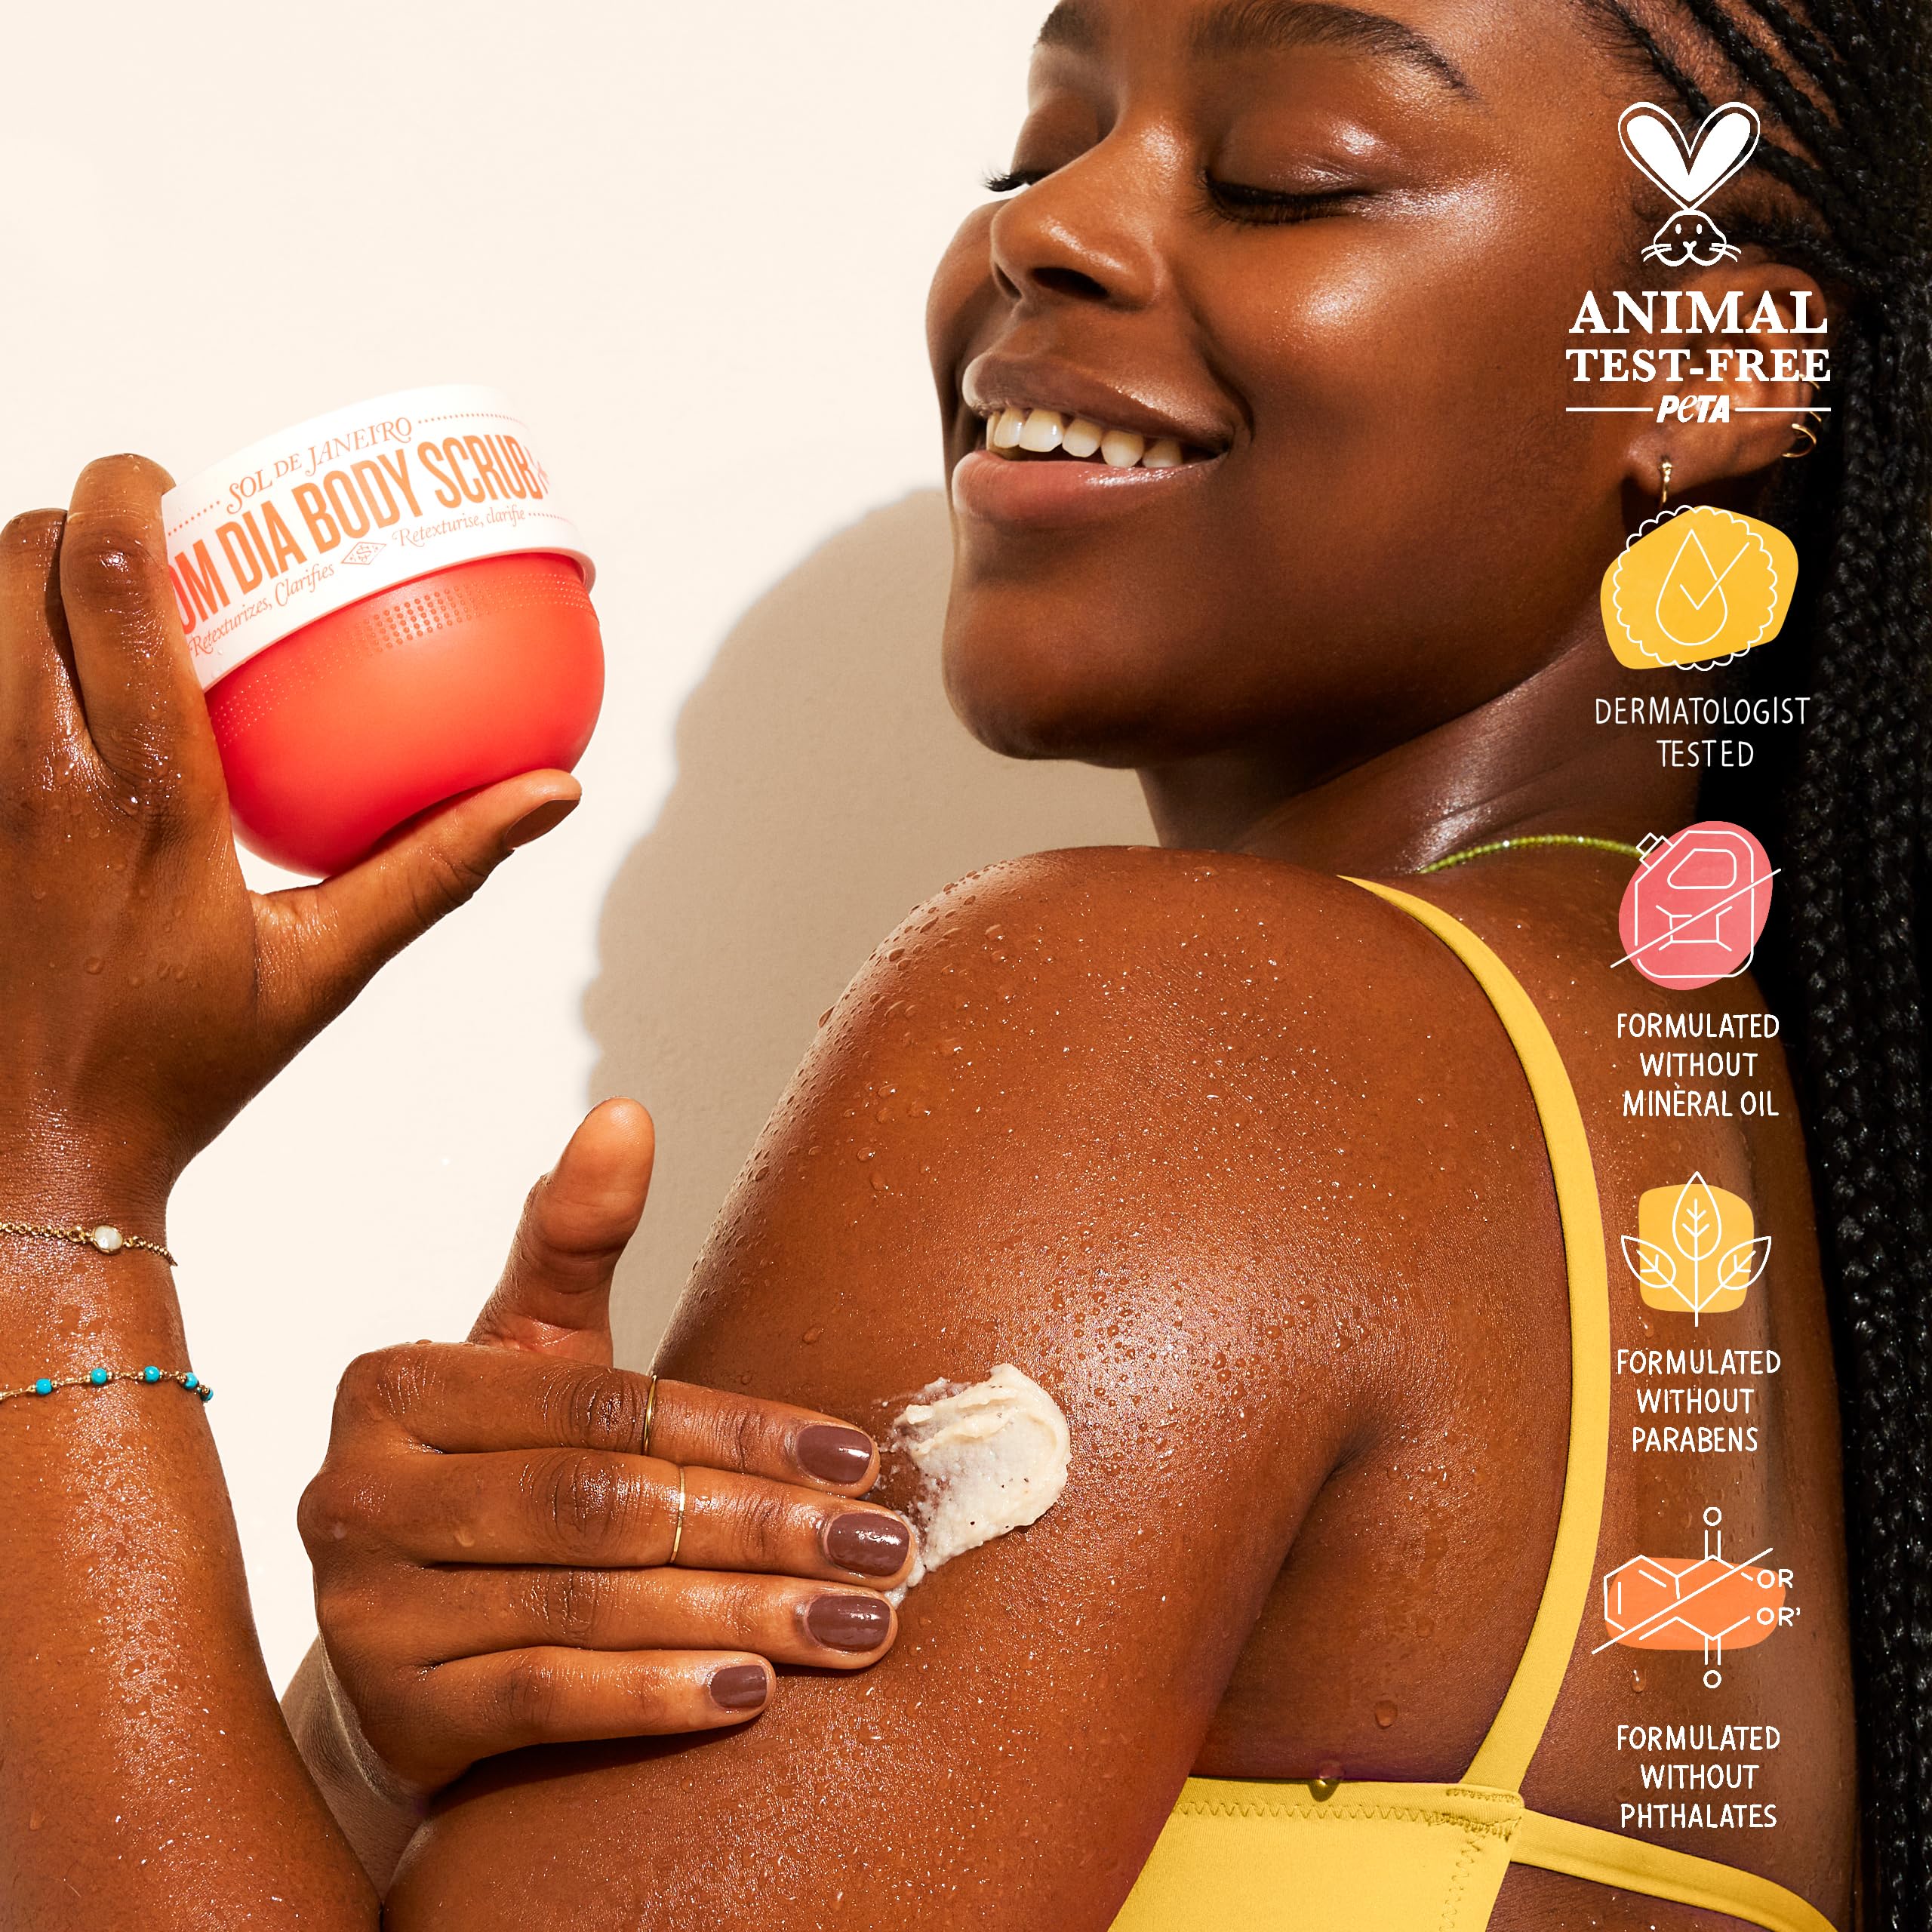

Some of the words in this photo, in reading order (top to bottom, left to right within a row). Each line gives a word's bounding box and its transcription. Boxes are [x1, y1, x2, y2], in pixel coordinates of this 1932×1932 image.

[226, 469, 273, 515] SOL
[273, 453, 303, 479] DE
[304, 417, 412, 477] JANEIRO
[215, 500, 308, 595] DIA
[291, 448, 423, 555] BODY
[417, 434, 544, 509] SCRUB
[392, 512, 485, 548] Retexturise,
[485, 503, 526, 528] clarifie
[189, 596, 273, 657] Retexturizes,
[275, 563, 335, 607] Clarifies
